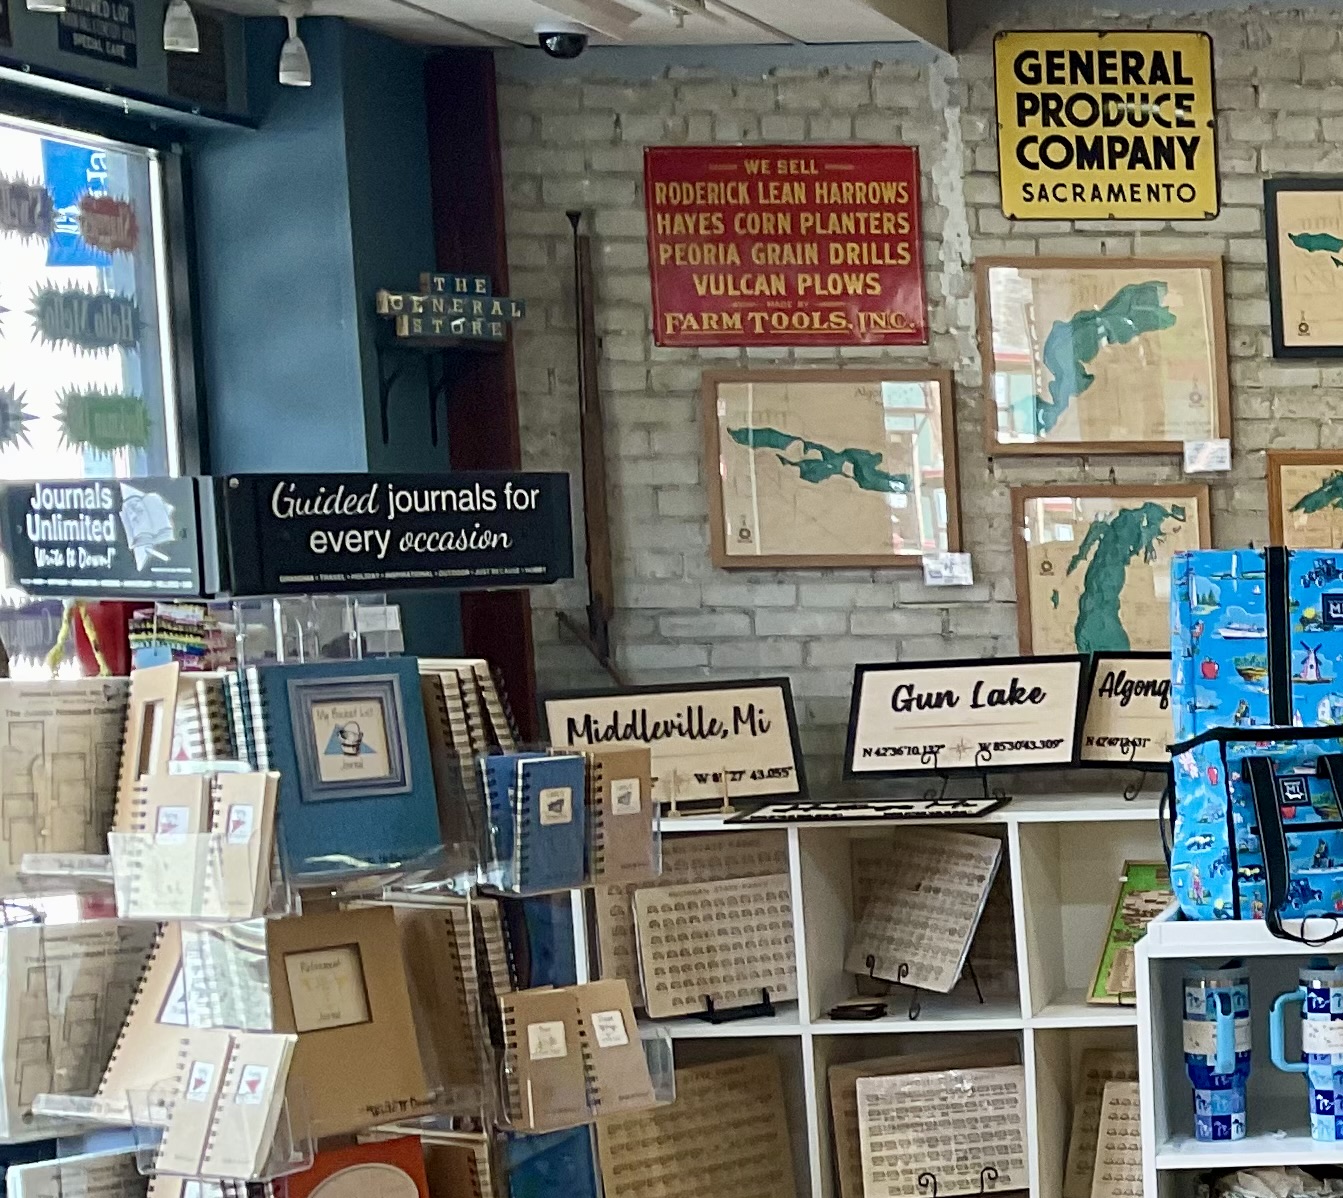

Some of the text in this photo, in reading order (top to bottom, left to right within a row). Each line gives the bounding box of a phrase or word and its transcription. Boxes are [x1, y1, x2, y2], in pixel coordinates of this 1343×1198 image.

[1014, 50, 1194, 85] GENERAL
[1016, 92, 1196, 128] PRODUCE
[1016, 135, 1201, 170] COMPANY
[744, 159, 819, 175] WE SELL
[655, 180, 909, 205] RODERICK LEAN HARROWS
[1022, 183, 1196, 203] SACRAMENTO
[656, 212, 910, 236] HAYES CORN PLANTERS
[659, 242, 911, 266] PEORIA GRAIN DRILLS
[433, 276, 487, 294] THE
[692, 272, 882, 296] VULCAN PLOWS
[388, 294, 522, 318] GENERAL
[412, 316, 503, 336] STORE
[664, 311, 743, 334] FARM
[857, 311, 917, 334] INC.
[30, 481, 114, 511] Journals
[271, 480, 541, 520] Guided journals for
[25, 513, 117, 543] Unlimited
[309, 522, 514, 560] every occasion
[34, 546, 64, 569] Write
[66, 546, 76, 568] It
[891, 677, 1047, 712] Gun Lake
[1097, 670, 1170, 710] Algonq
[733, 703, 771, 737] Mi
[862, 741, 991, 758] N W
[694, 772, 710, 783] W
